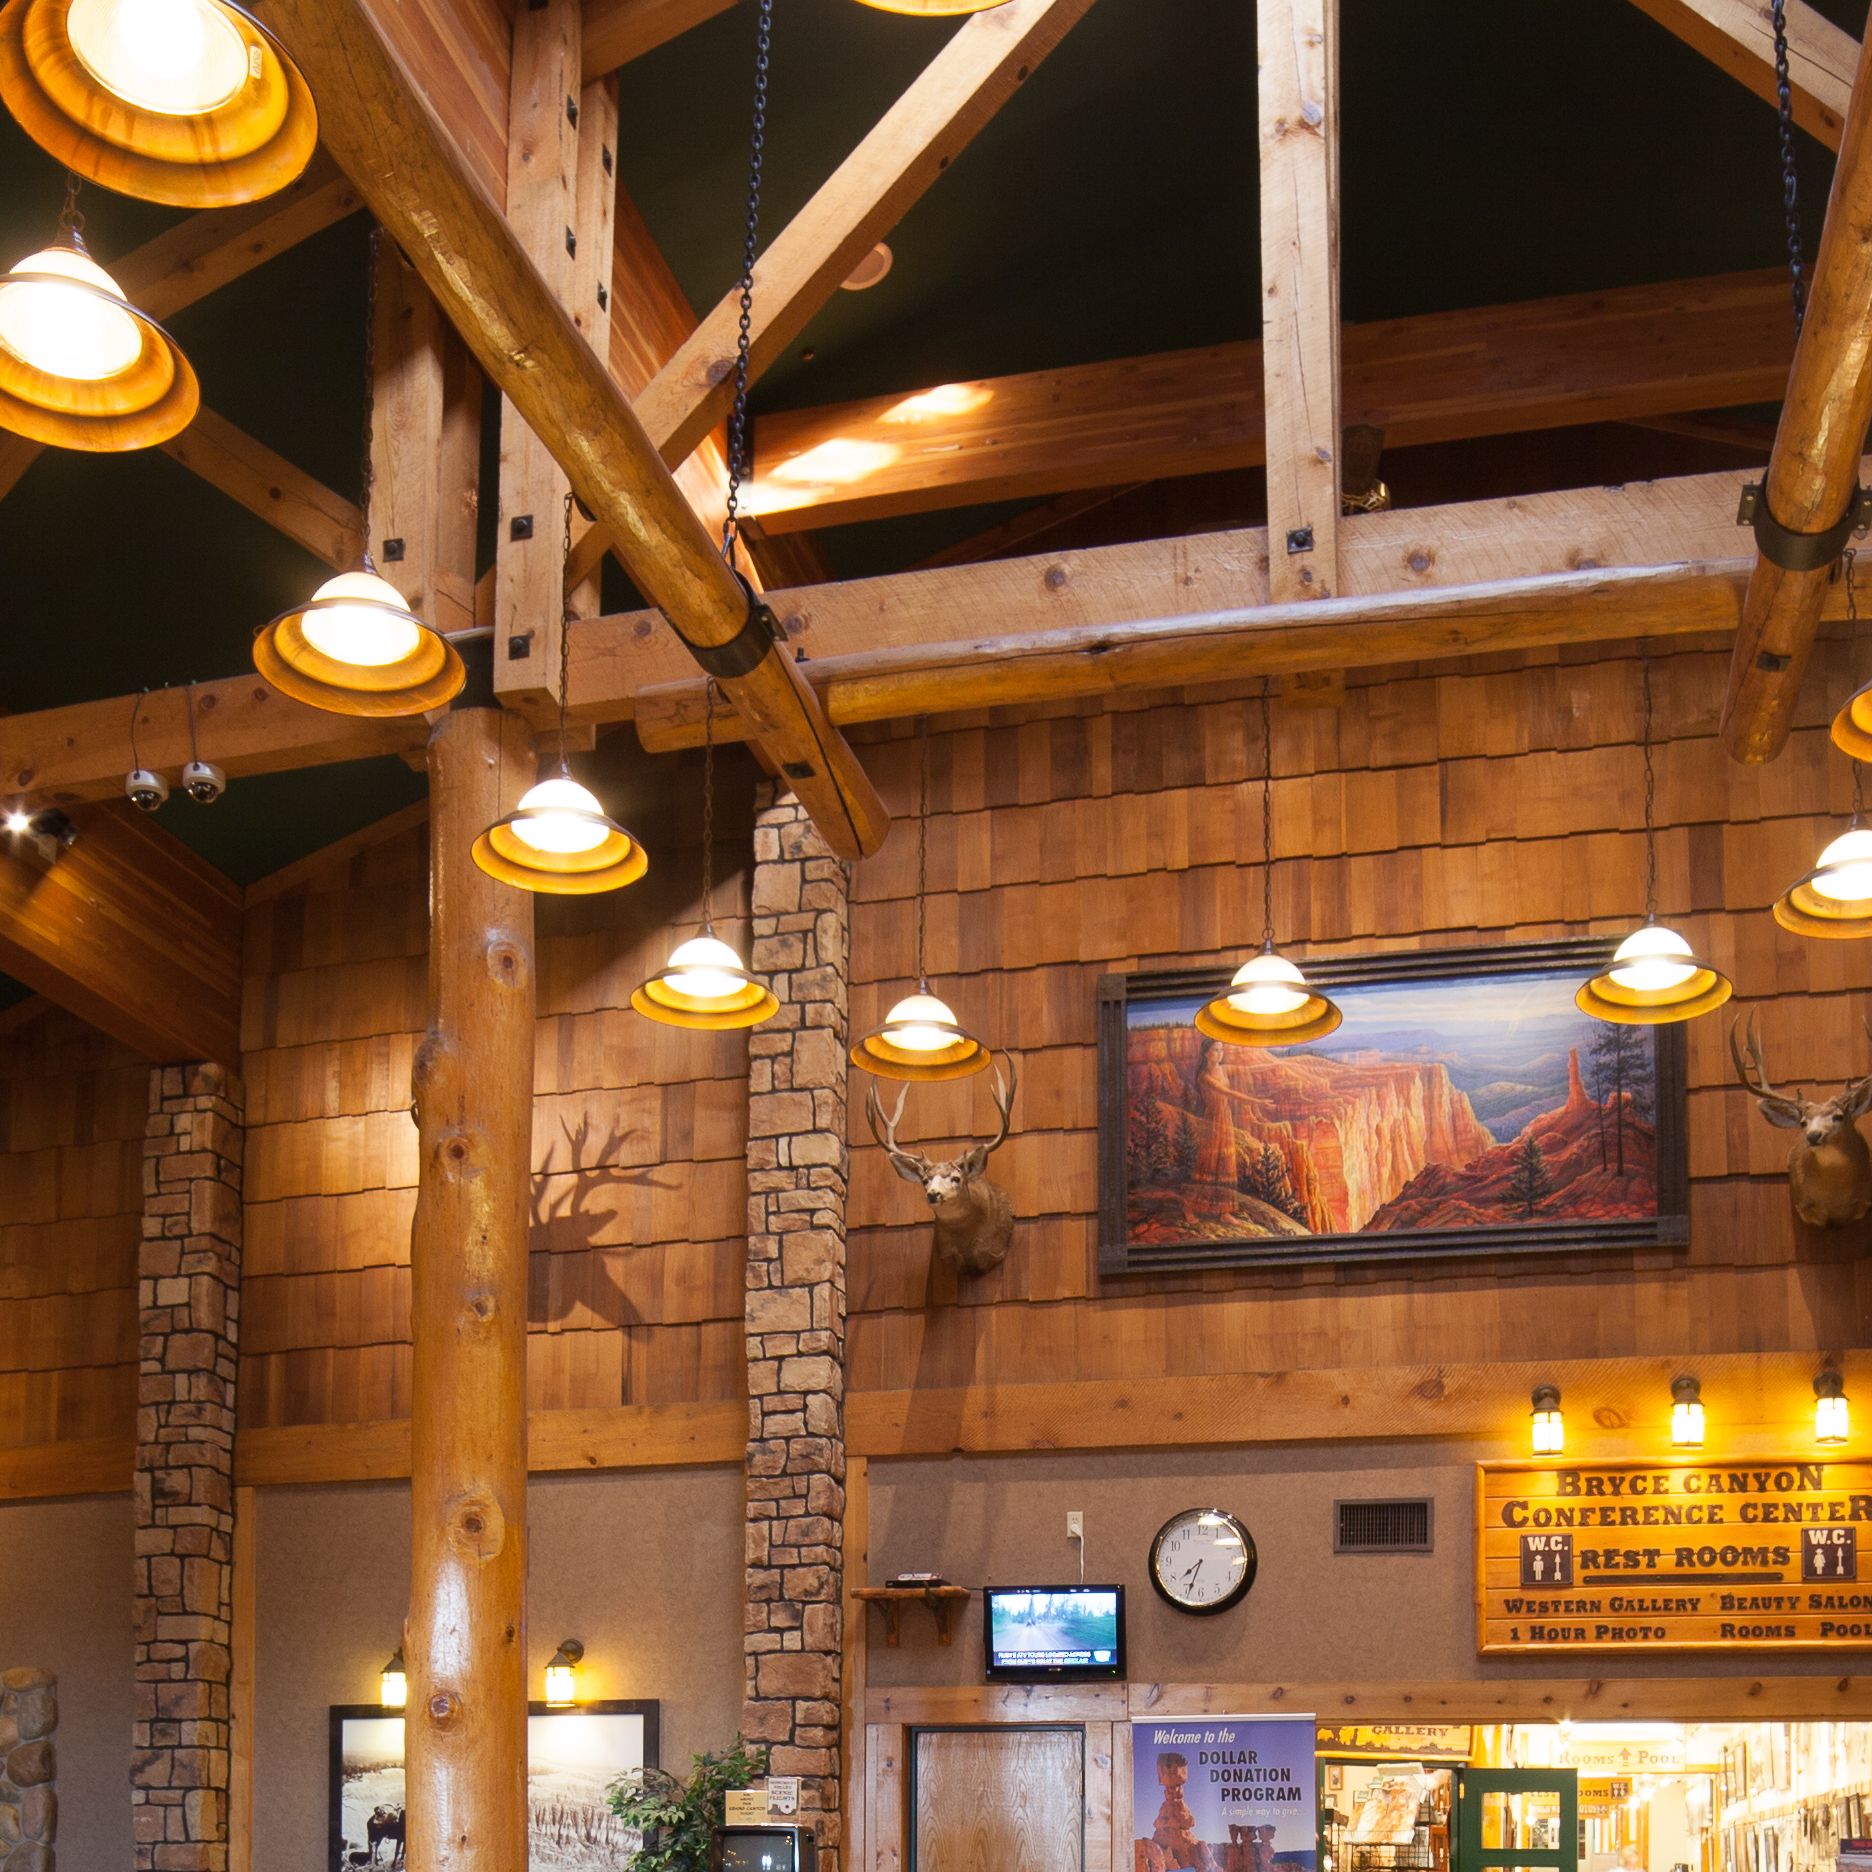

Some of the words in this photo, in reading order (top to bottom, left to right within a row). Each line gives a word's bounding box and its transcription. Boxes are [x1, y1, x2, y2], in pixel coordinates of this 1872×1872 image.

[1556, 1471, 1670, 1496] BRYCE
[1683, 1463, 1824, 1493] CANYON
[1501, 1500, 1724, 1528] CONFERENCE
[1527, 1536, 1569, 1551] W.C.
[1809, 1529, 1851, 1545] W.C.
[1580, 1547, 1661, 1570] REST
[1674, 1545, 1791, 1569] ROOMS
[1504, 1598, 1601, 1614] WESTERN
[1608, 1596, 1701, 1613] GALLERY
[1719, 1594, 1800, 1611] BEAUTY
[1510, 1626, 1520, 1641] 1
[1530, 1625, 1586, 1641] HOUR
[1594, 1624, 1666, 1641] PHOTO
[1720, 1623, 1796, 1639] ROOMS
[1153, 1728, 1201, 1744] Welcome
[1204, 1730, 1214, 1744] to
[1217, 1728, 1236, 1743] the
[1371, 1726, 1448, 1737] GALLERY
[1199, 1750, 1258, 1765] DOLLAR
[1210, 1768, 1291, 1783] DONATION
[1221, 1787, 1302, 1802] PROGRAM
[1228, 1806, 1254, 1817] simple
